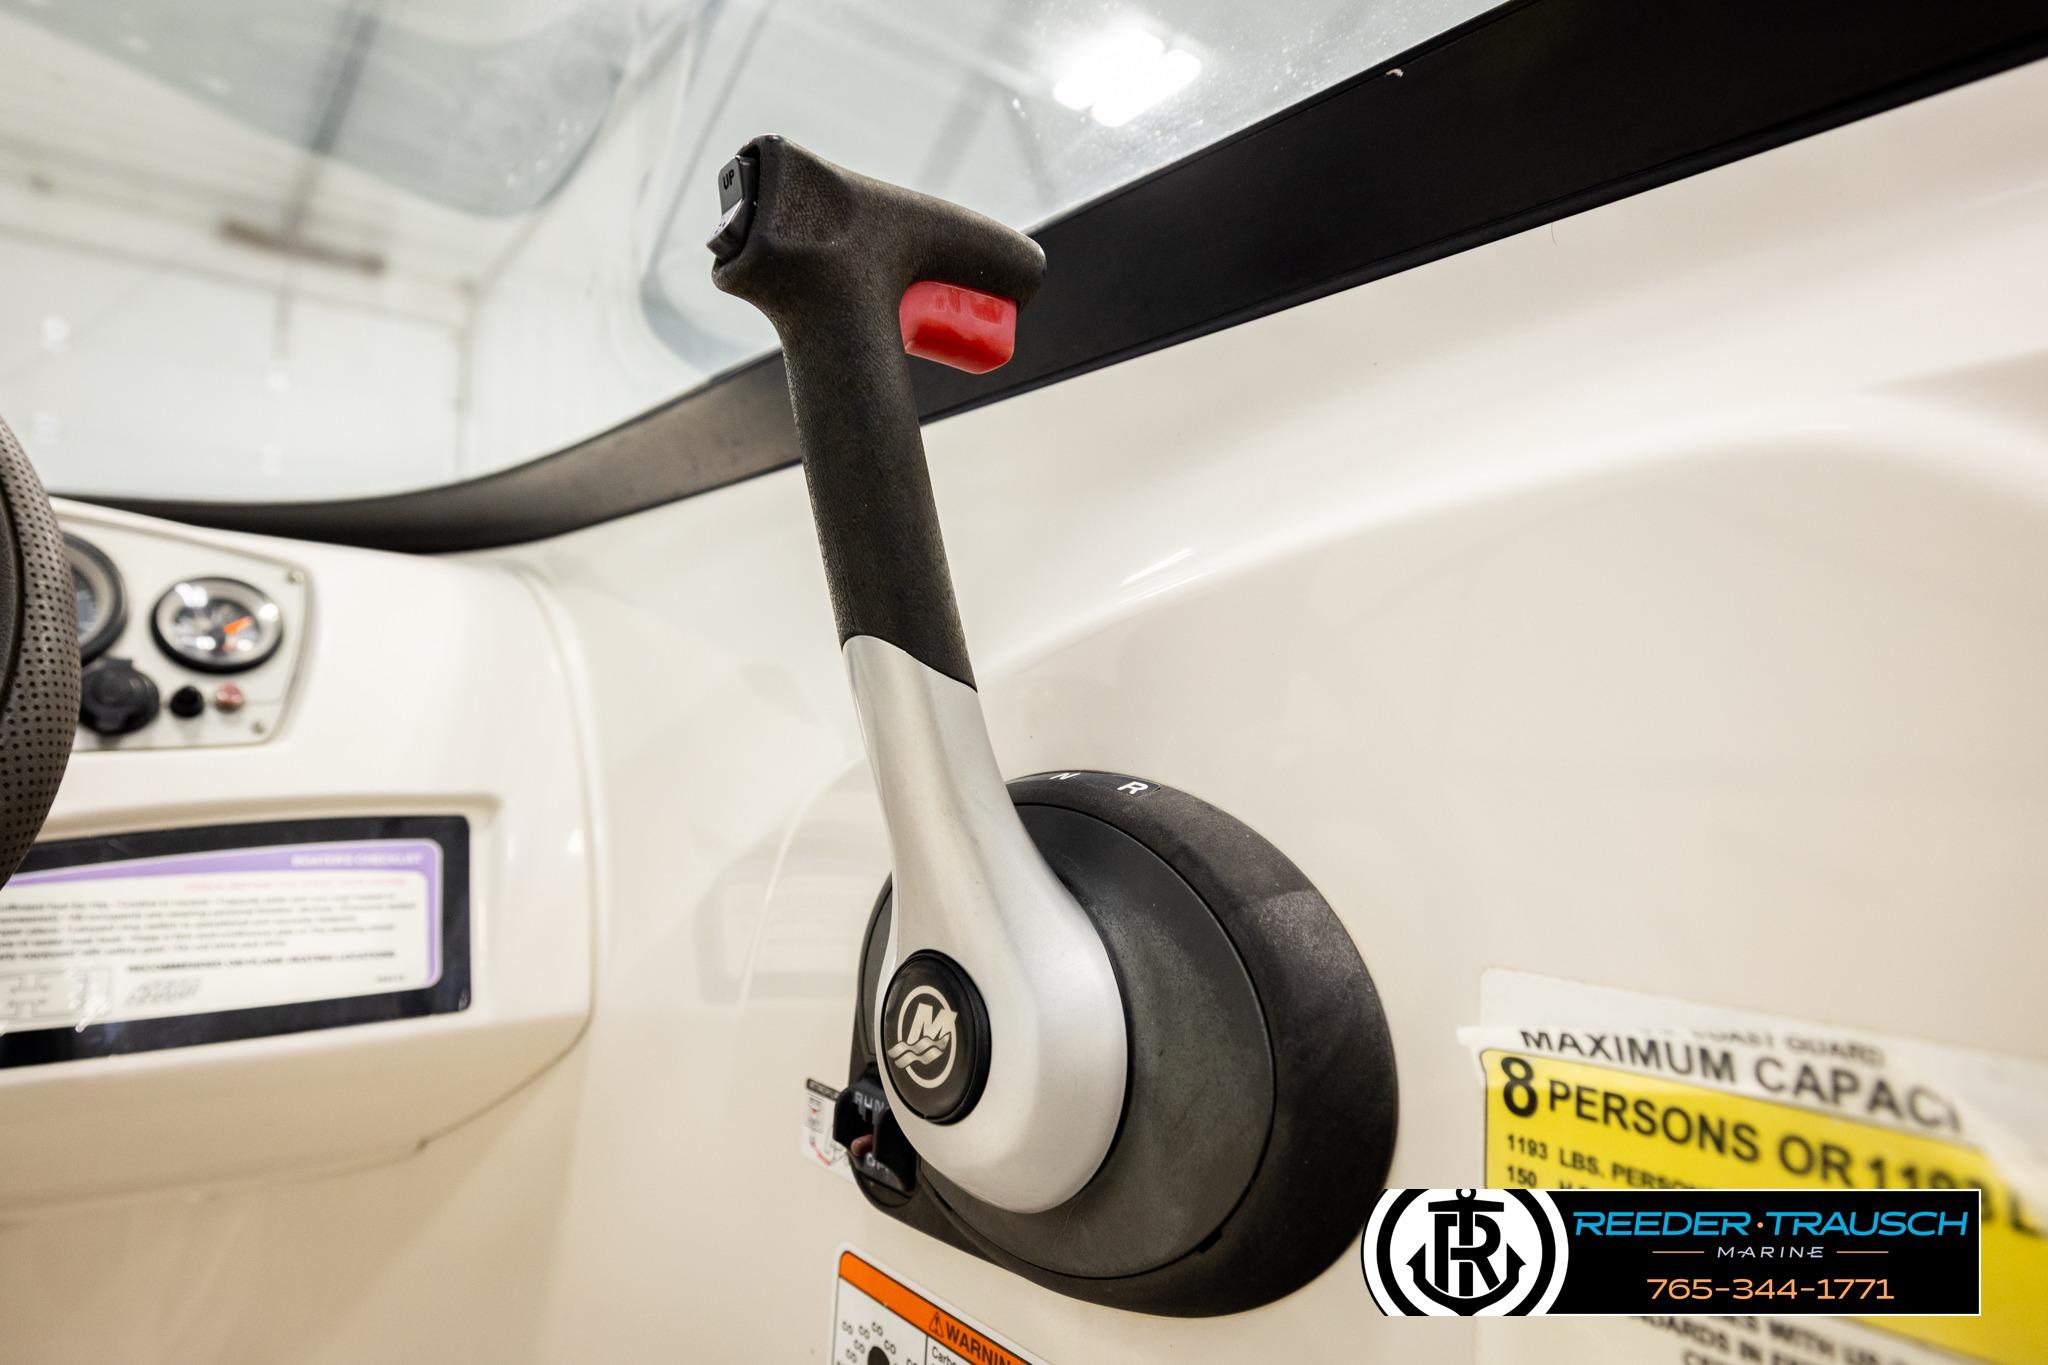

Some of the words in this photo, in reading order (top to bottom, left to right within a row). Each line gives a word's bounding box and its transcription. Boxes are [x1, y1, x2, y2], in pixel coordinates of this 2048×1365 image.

[722, 168, 735, 190] UP
[1049, 772, 1080, 781] N
[1116, 781, 1149, 795] R
[1521, 1031, 1736, 1082] MAXIMUM
[853, 1091, 885, 1113] RUN
[1500, 1056, 1538, 1118] 8
[1549, 1079, 1760, 1163] PERSONS
[1779, 1135, 1853, 1188] OR
[1507, 1134, 1548, 1160] 1193
[1507, 1165, 1537, 1188] 150
